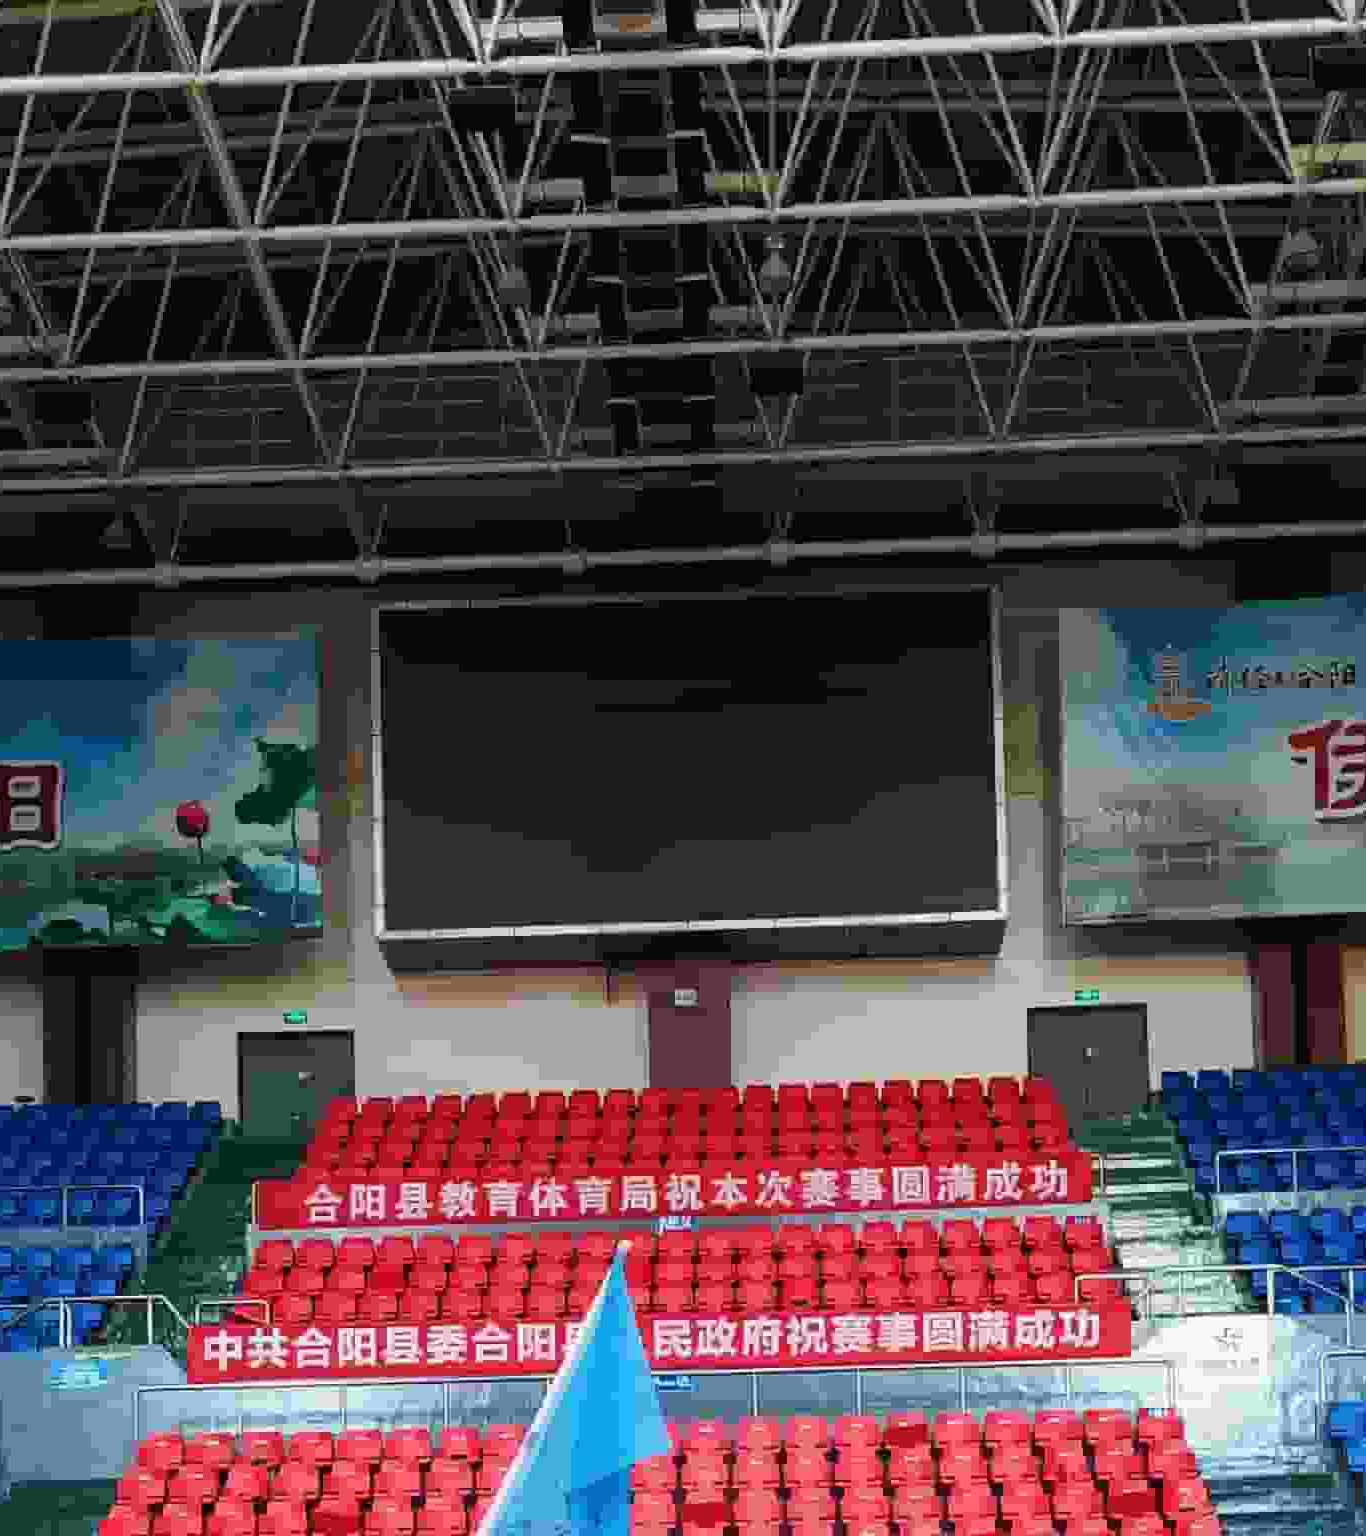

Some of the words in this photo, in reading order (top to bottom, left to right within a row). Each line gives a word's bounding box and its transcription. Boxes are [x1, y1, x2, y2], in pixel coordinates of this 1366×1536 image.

[303, 1159, 1068, 1222] 合阳县教育体育局祝本次赛事圆满成功
[203, 1310, 1100, 1372] 中共合阳县委合阳民政府祝赛事圆满成功
